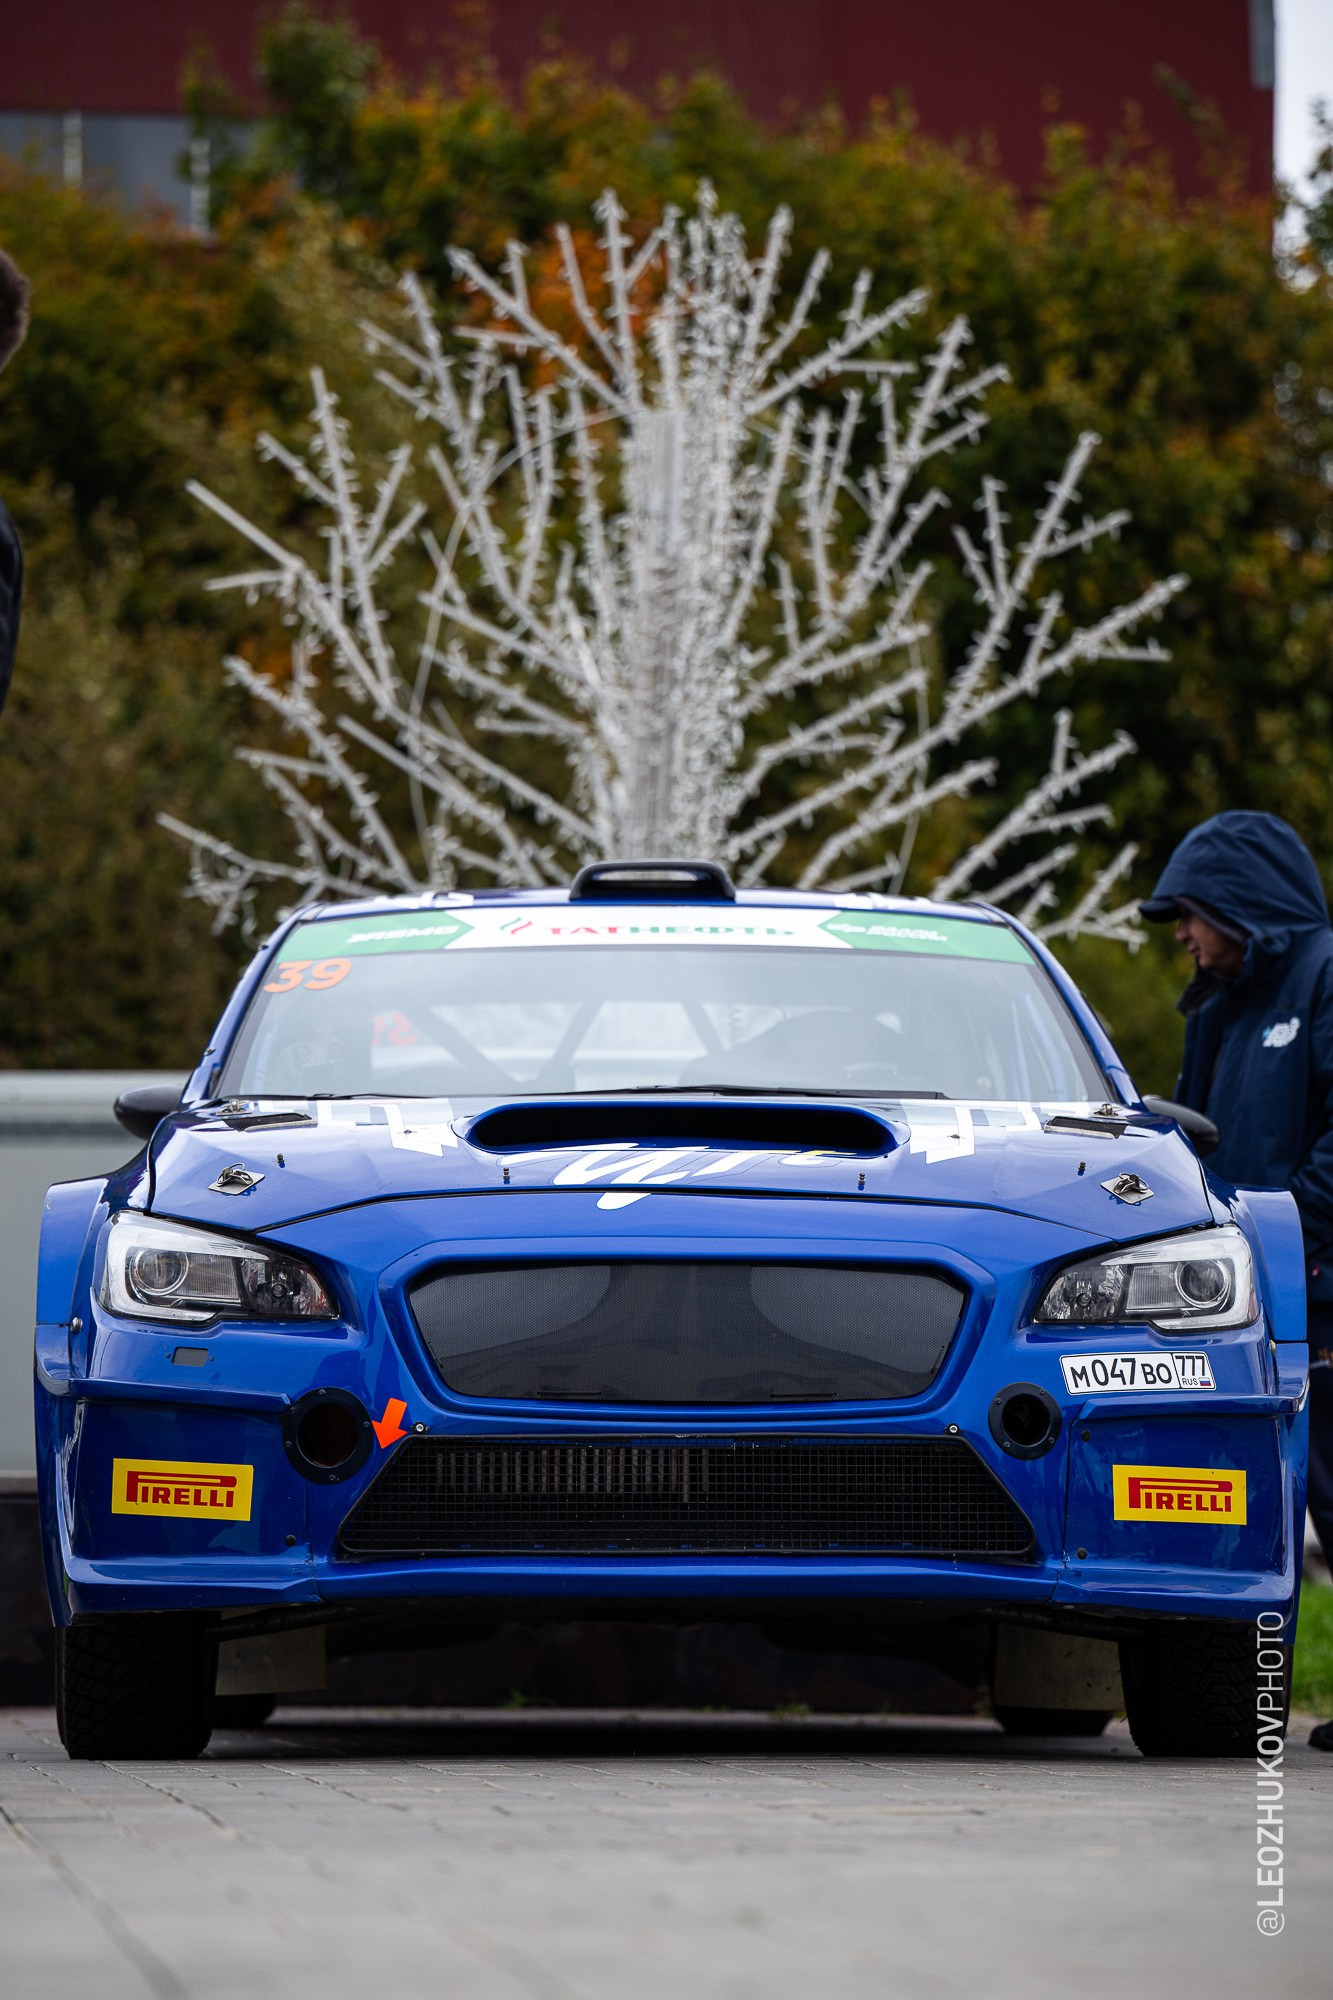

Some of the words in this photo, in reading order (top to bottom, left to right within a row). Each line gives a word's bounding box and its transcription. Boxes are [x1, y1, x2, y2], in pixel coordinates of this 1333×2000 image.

[543, 926, 794, 936] ТАТНЕФТЬ
[263, 958, 351, 993] 39
[1175, 1356, 1205, 1377] 777
[1182, 1378, 1198, 1386] RUS
[126, 1471, 237, 1508] PIRELLI
[1128, 1477, 1233, 1512] PIRELLI
